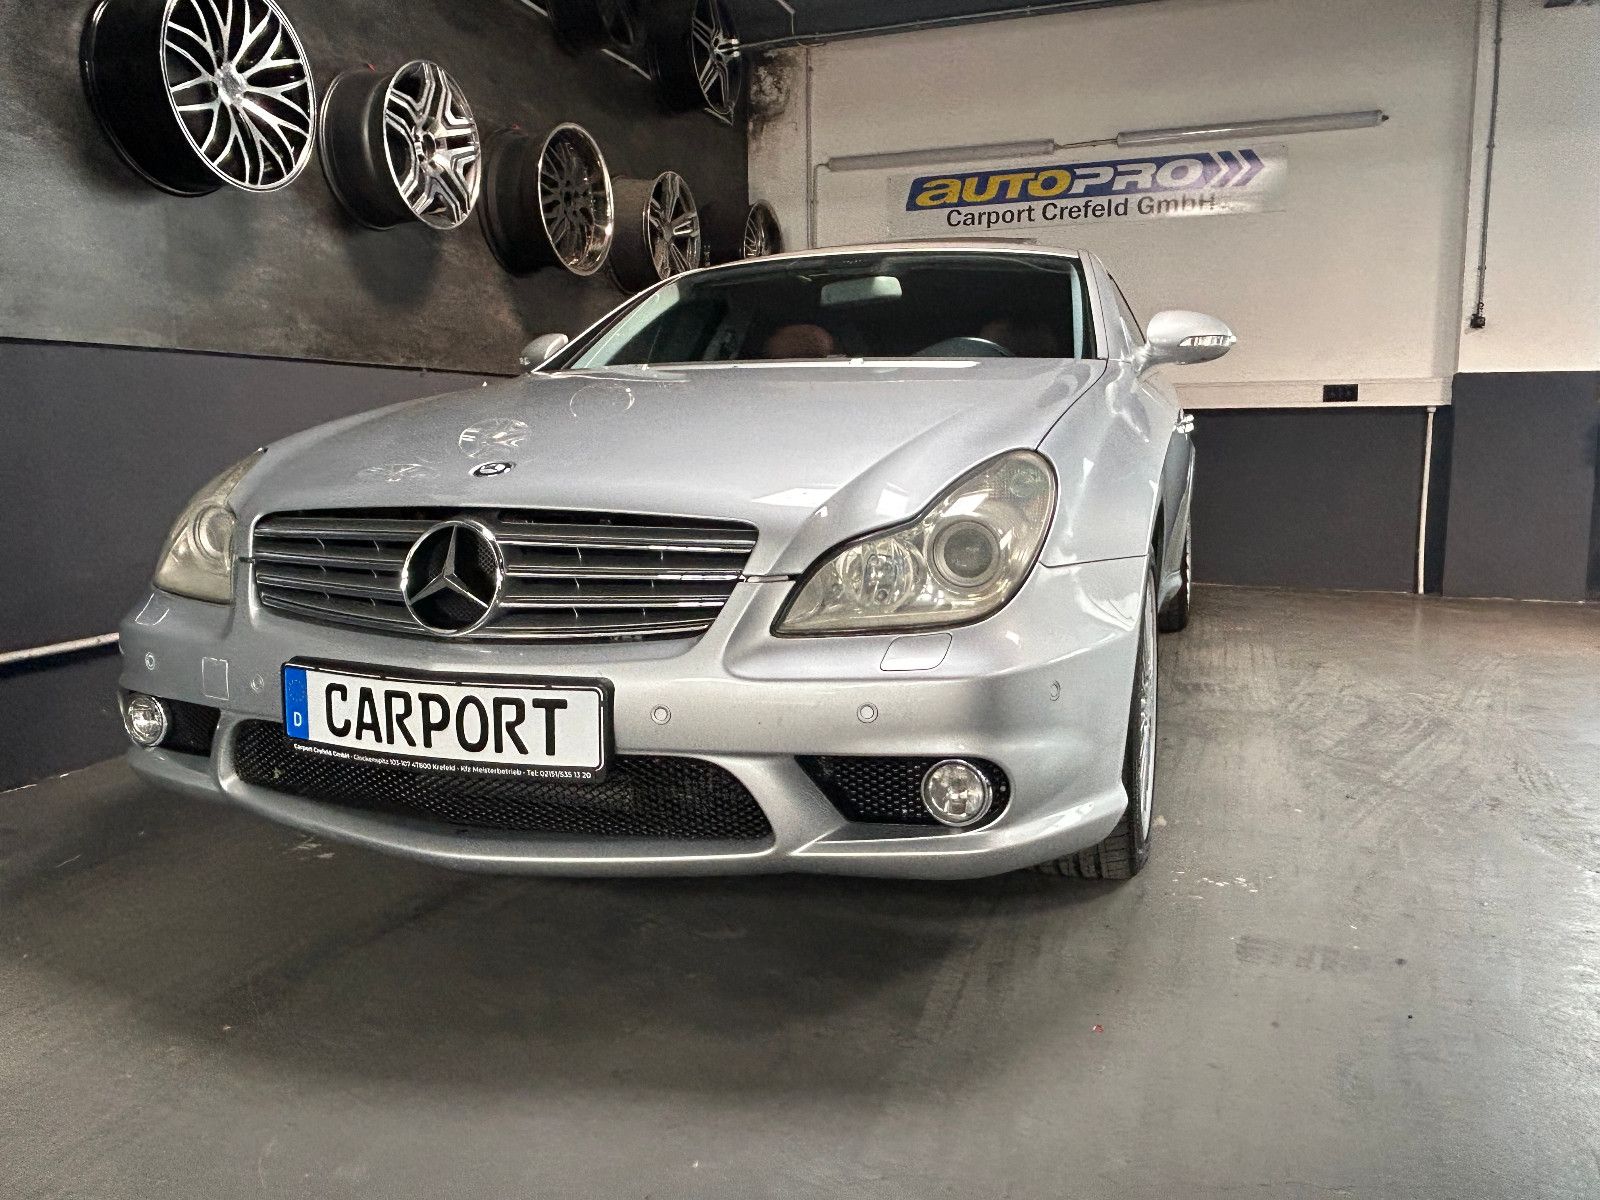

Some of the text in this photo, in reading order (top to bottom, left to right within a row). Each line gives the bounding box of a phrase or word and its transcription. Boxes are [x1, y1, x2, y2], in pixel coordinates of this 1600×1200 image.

[947, 194, 1215, 228] Carport Crefeld GmbH
[293, 711, 302, 727] D
[325, 683, 568, 756] CARPORT
[293, 743, 312, 752] Carport
[432, 763, 456, 771] Krefeld
[460, 765, 471, 773] Kfz
[472, 766, 522, 776] Meisterbetrieb
[574, 771, 580, 779] 13
[582, 771, 592, 779] 20
